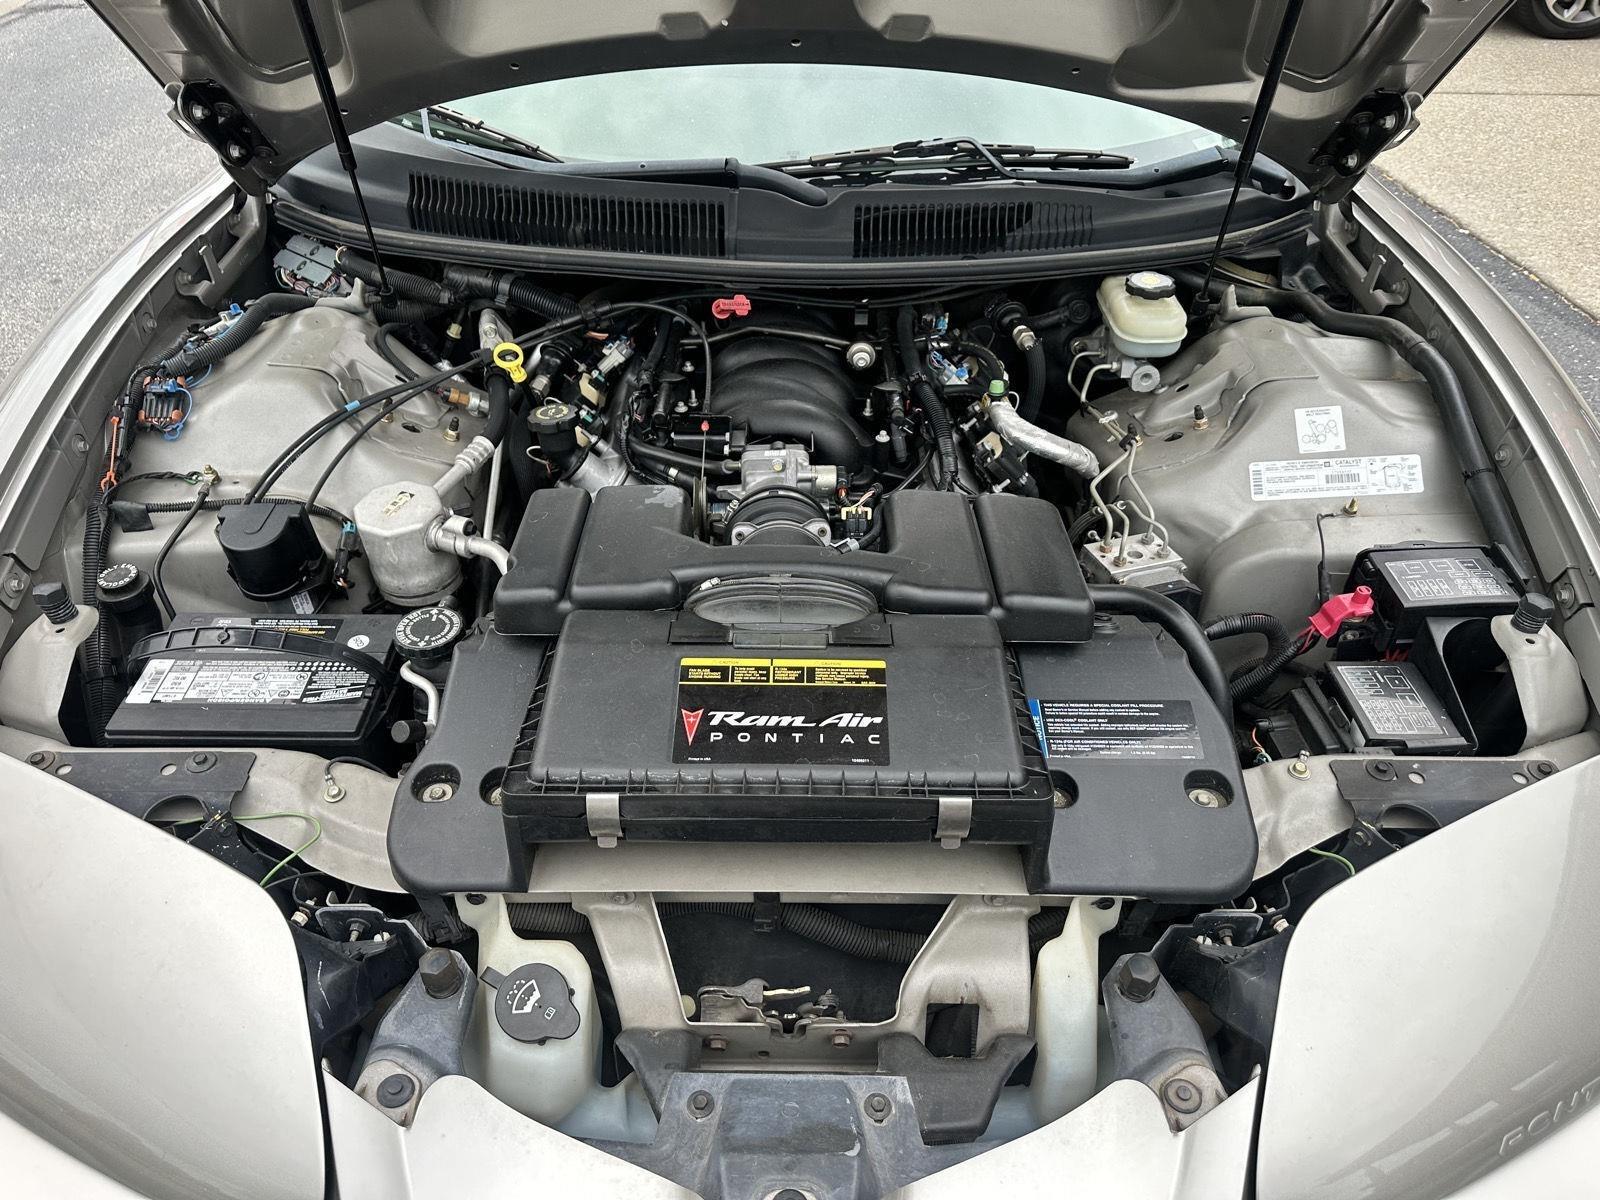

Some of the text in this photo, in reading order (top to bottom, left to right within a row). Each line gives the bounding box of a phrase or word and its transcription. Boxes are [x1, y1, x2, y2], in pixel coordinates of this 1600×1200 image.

[97, 563, 137, 588] ONLY ENGINE COOLANT
[708, 711, 883, 727] Ram Air
[1032, 716, 1043, 740] NOTICE
[710, 733, 880, 745] PONTIAC
